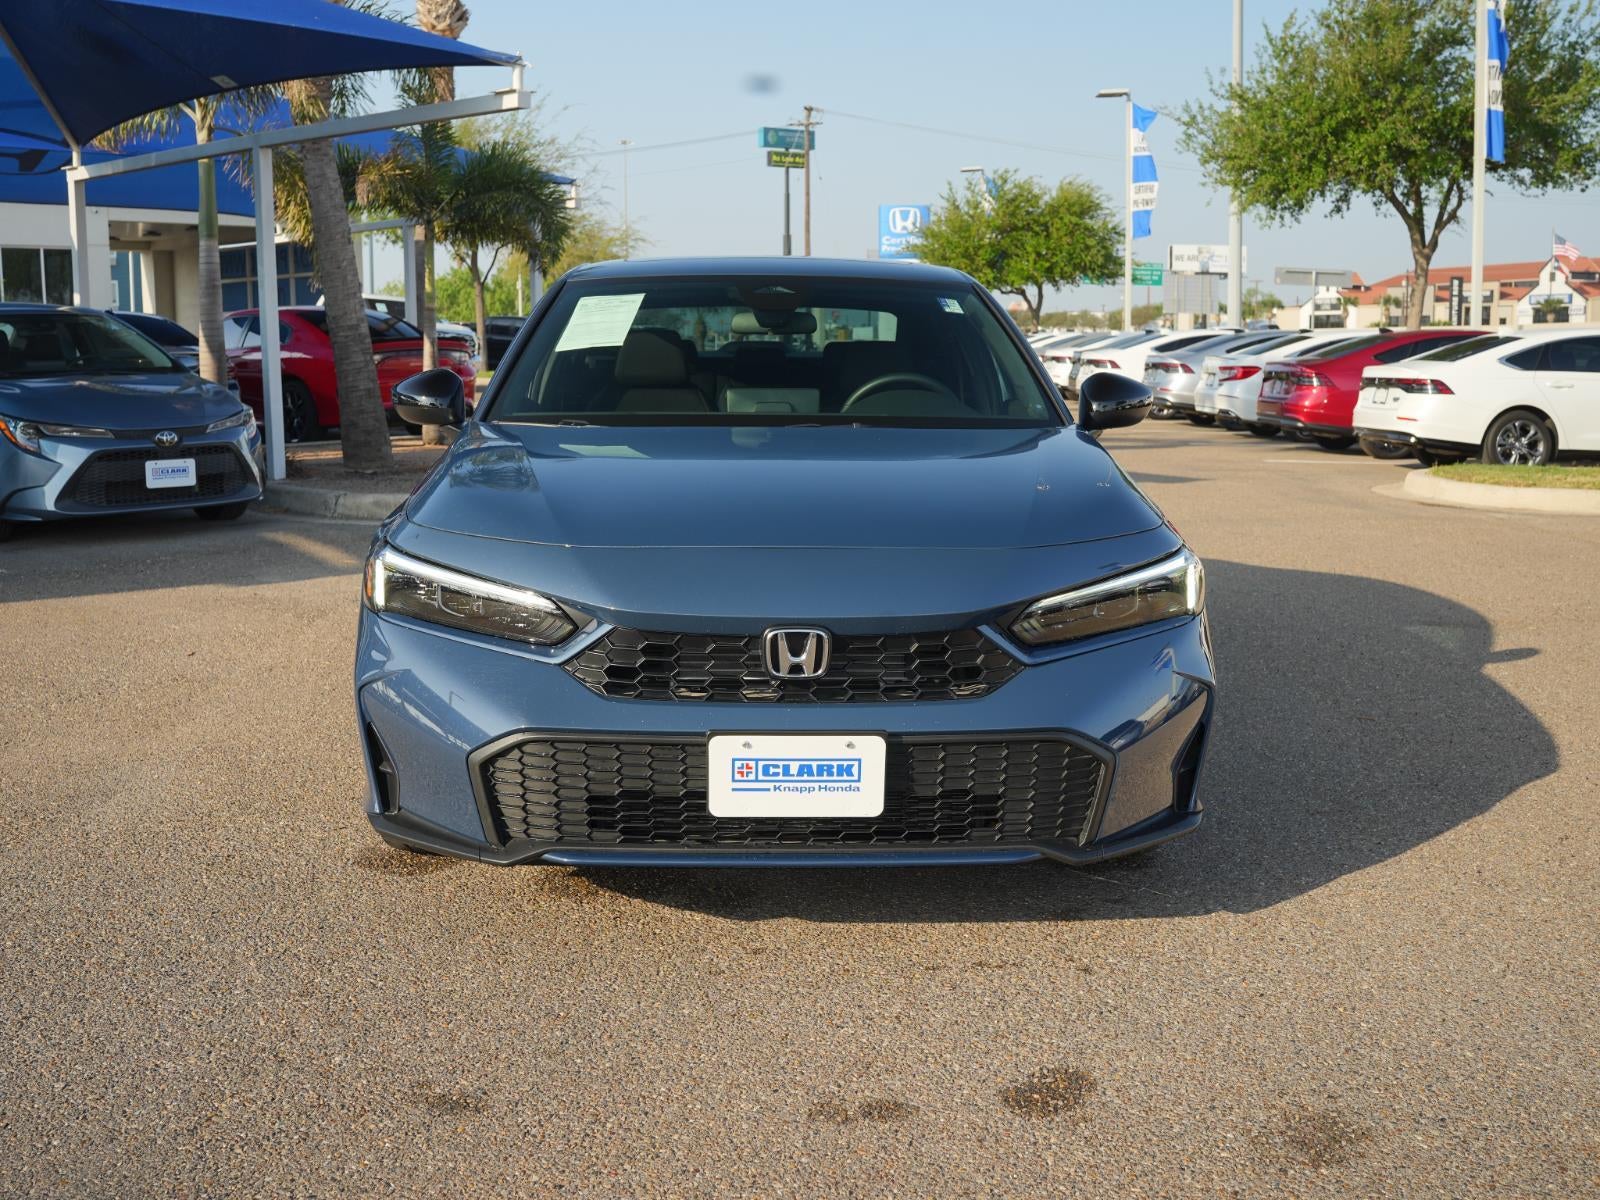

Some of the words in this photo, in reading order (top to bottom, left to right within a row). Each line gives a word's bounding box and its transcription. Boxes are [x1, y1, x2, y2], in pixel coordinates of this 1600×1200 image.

[761, 763, 855, 778] CLARK
[773, 784, 816, 794] Knapp
[818, 784, 861, 793] Honda
